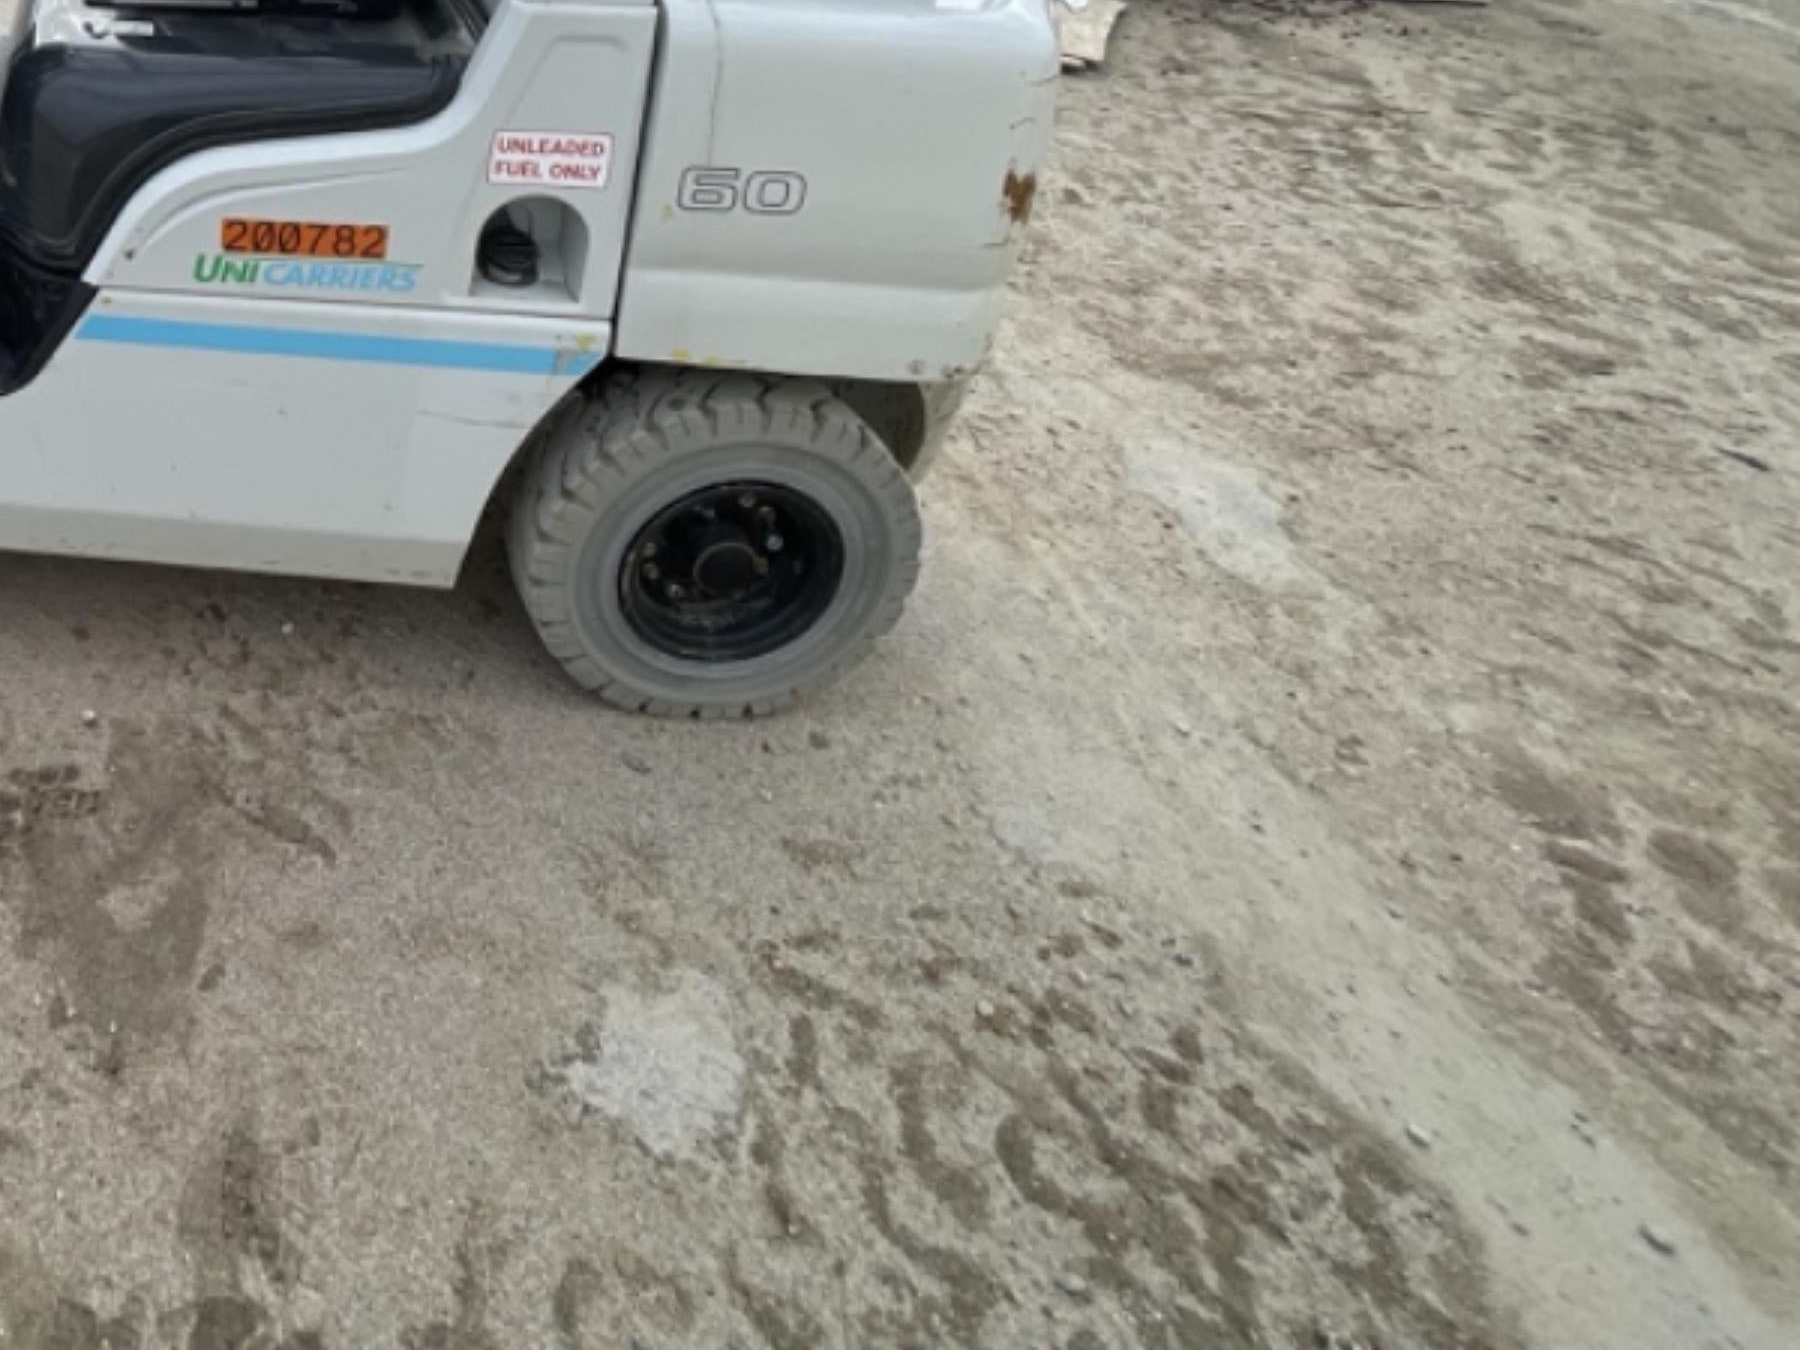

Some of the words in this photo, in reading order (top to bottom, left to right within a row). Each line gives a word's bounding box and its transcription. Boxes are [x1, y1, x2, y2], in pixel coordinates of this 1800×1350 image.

[498, 137, 604, 157] UNLEADED
[495, 159, 542, 180] FUEL
[548, 163, 601, 181] ONLY
[677, 167, 807, 216] 60
[224, 220, 386, 258] 200782
[193, 254, 424, 291] UNICARRIERS
